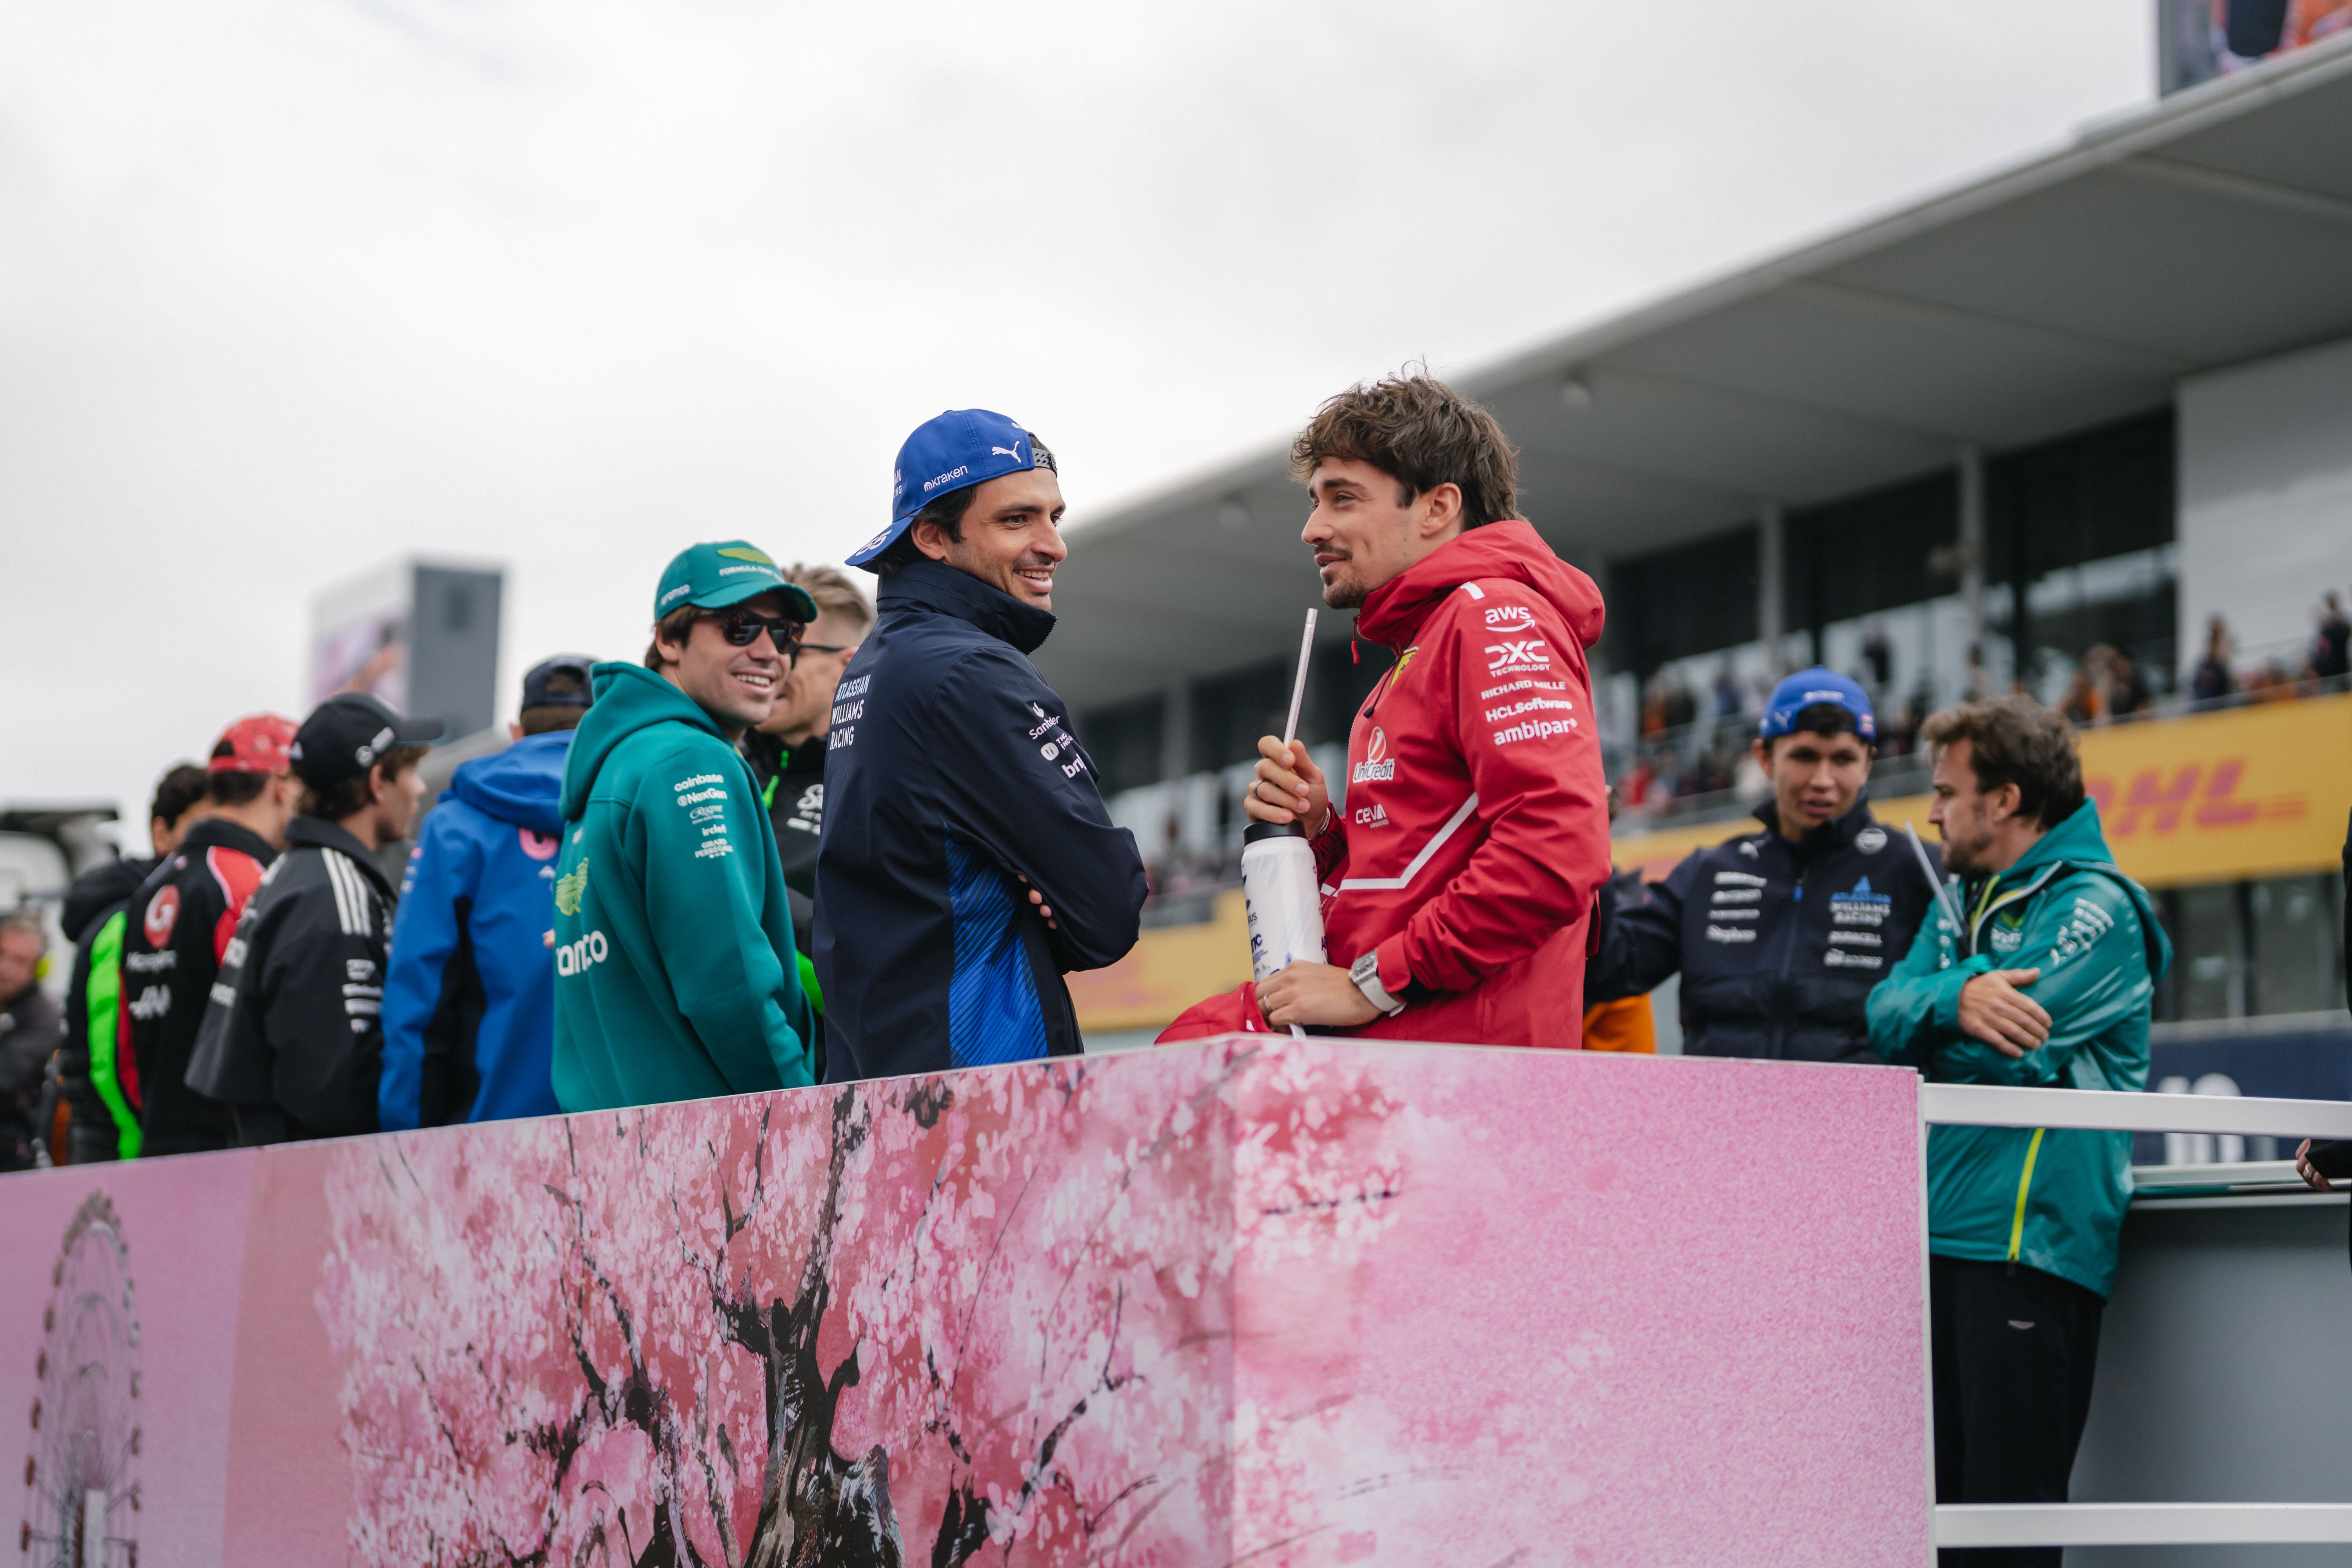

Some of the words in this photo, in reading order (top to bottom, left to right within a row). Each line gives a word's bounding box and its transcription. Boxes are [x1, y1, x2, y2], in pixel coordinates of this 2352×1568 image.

[931, 465, 968, 488] kraken
[1485, 606, 1531, 624] aws
[1484, 640, 1550, 669] DXC
[1490, 664, 1550, 678] TECHNOLOGY
[835, 674, 871, 702] ATLASSIAN
[1481, 680, 1533, 700] RICHARD
[1533, 681, 1566, 690] MILLE
[831, 699, 864, 726] WILLIAMS
[1485, 697, 1573, 722] HCLSoftware
[829, 726, 855, 751] RACING
[1353, 759, 1395, 782] UniCredit
[674, 774, 724, 792] coinbase
